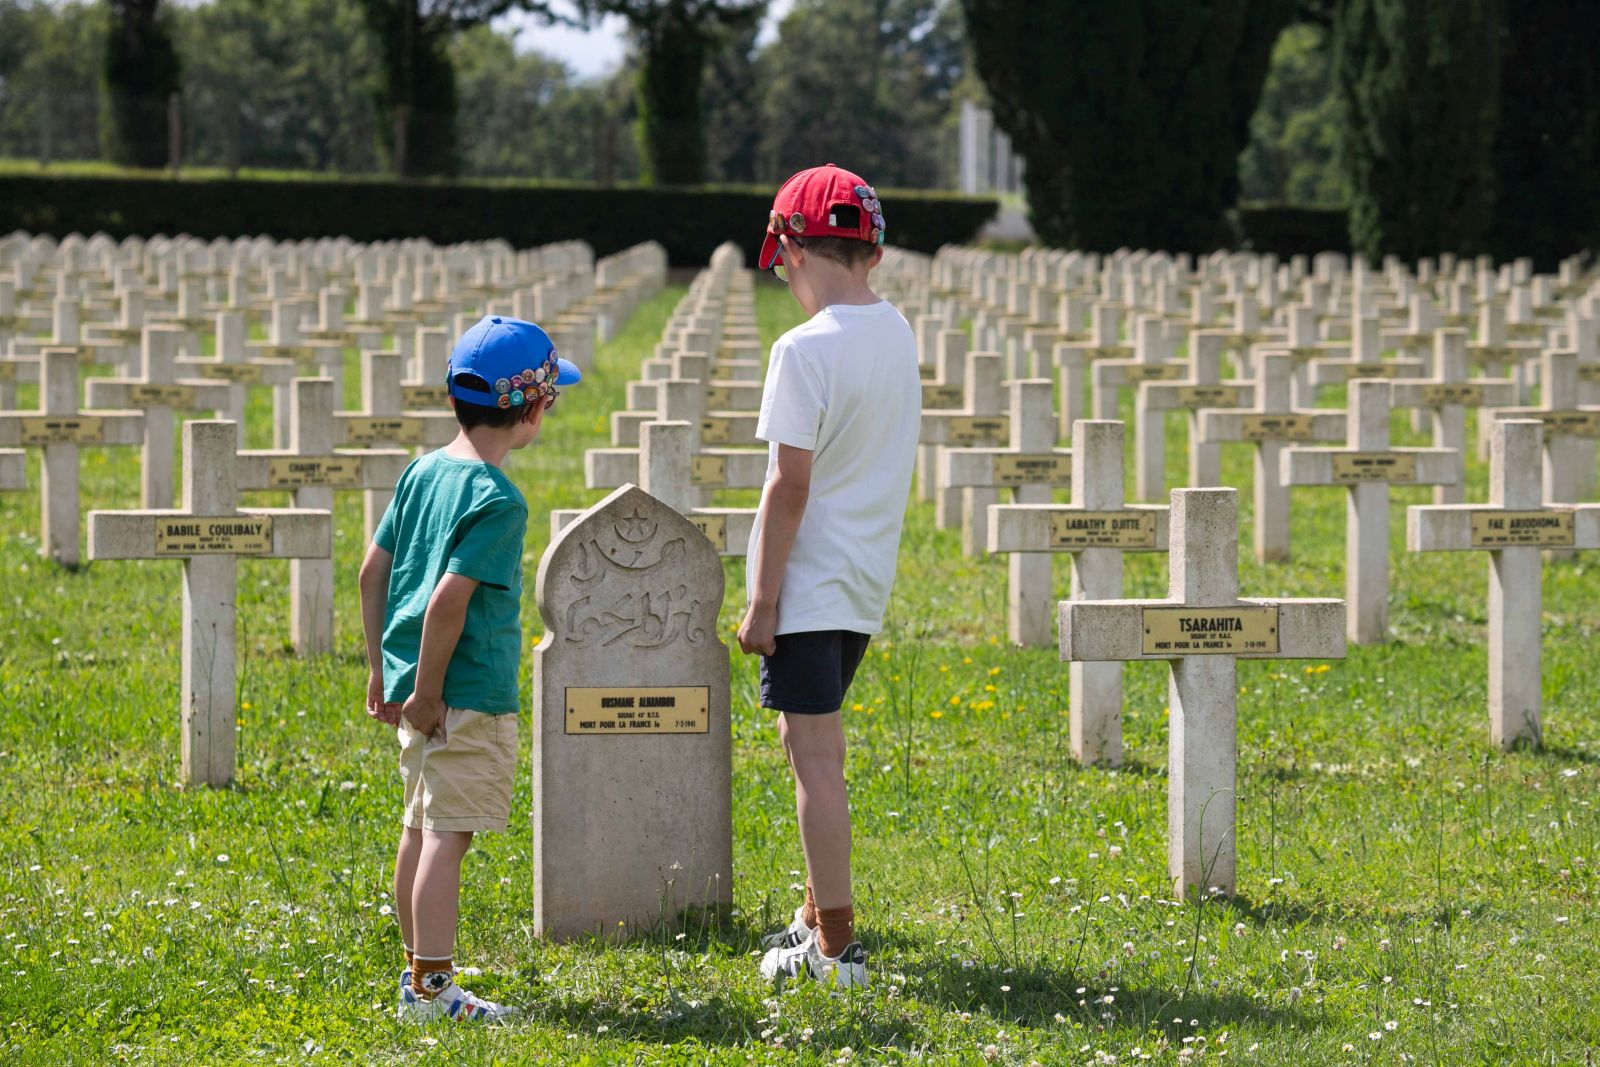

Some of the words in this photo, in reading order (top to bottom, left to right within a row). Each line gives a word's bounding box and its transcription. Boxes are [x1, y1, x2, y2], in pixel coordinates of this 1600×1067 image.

[167, 525, 200, 536] BABILE
[209, 524, 262, 536] COULIBALY
[1179, 618, 1242, 632] TSARAHITA
[580, 721, 596, 729] MORT
[600, 721, 616, 729] POUR
[629, 720, 651, 728] FRANCE
